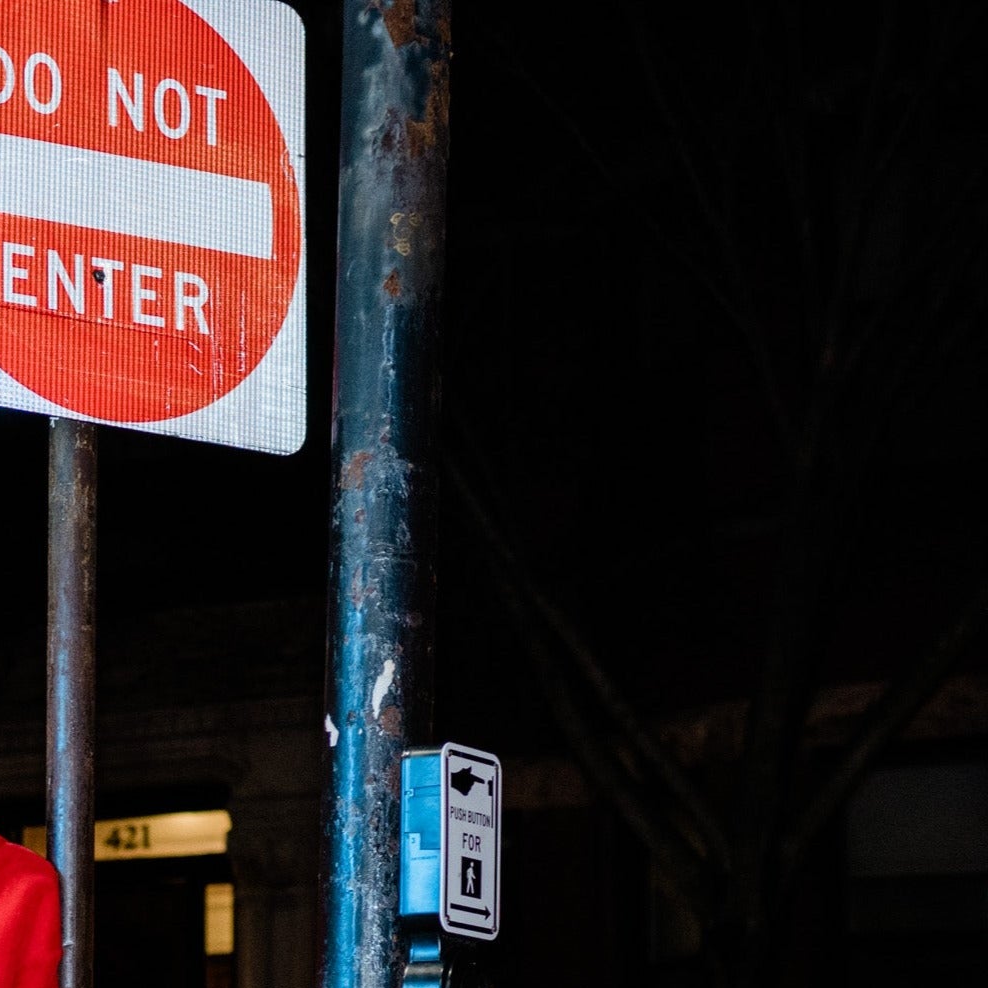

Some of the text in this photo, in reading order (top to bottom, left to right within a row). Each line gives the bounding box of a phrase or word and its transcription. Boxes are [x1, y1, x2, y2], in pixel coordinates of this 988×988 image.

[107, 67, 227, 147] NOT
[2, 241, 210, 335] ENTER
[450, 806, 491, 828] PUSH BUTTON
[105, 824, 150, 849] 421
[462, 832, 482, 853] FOR
